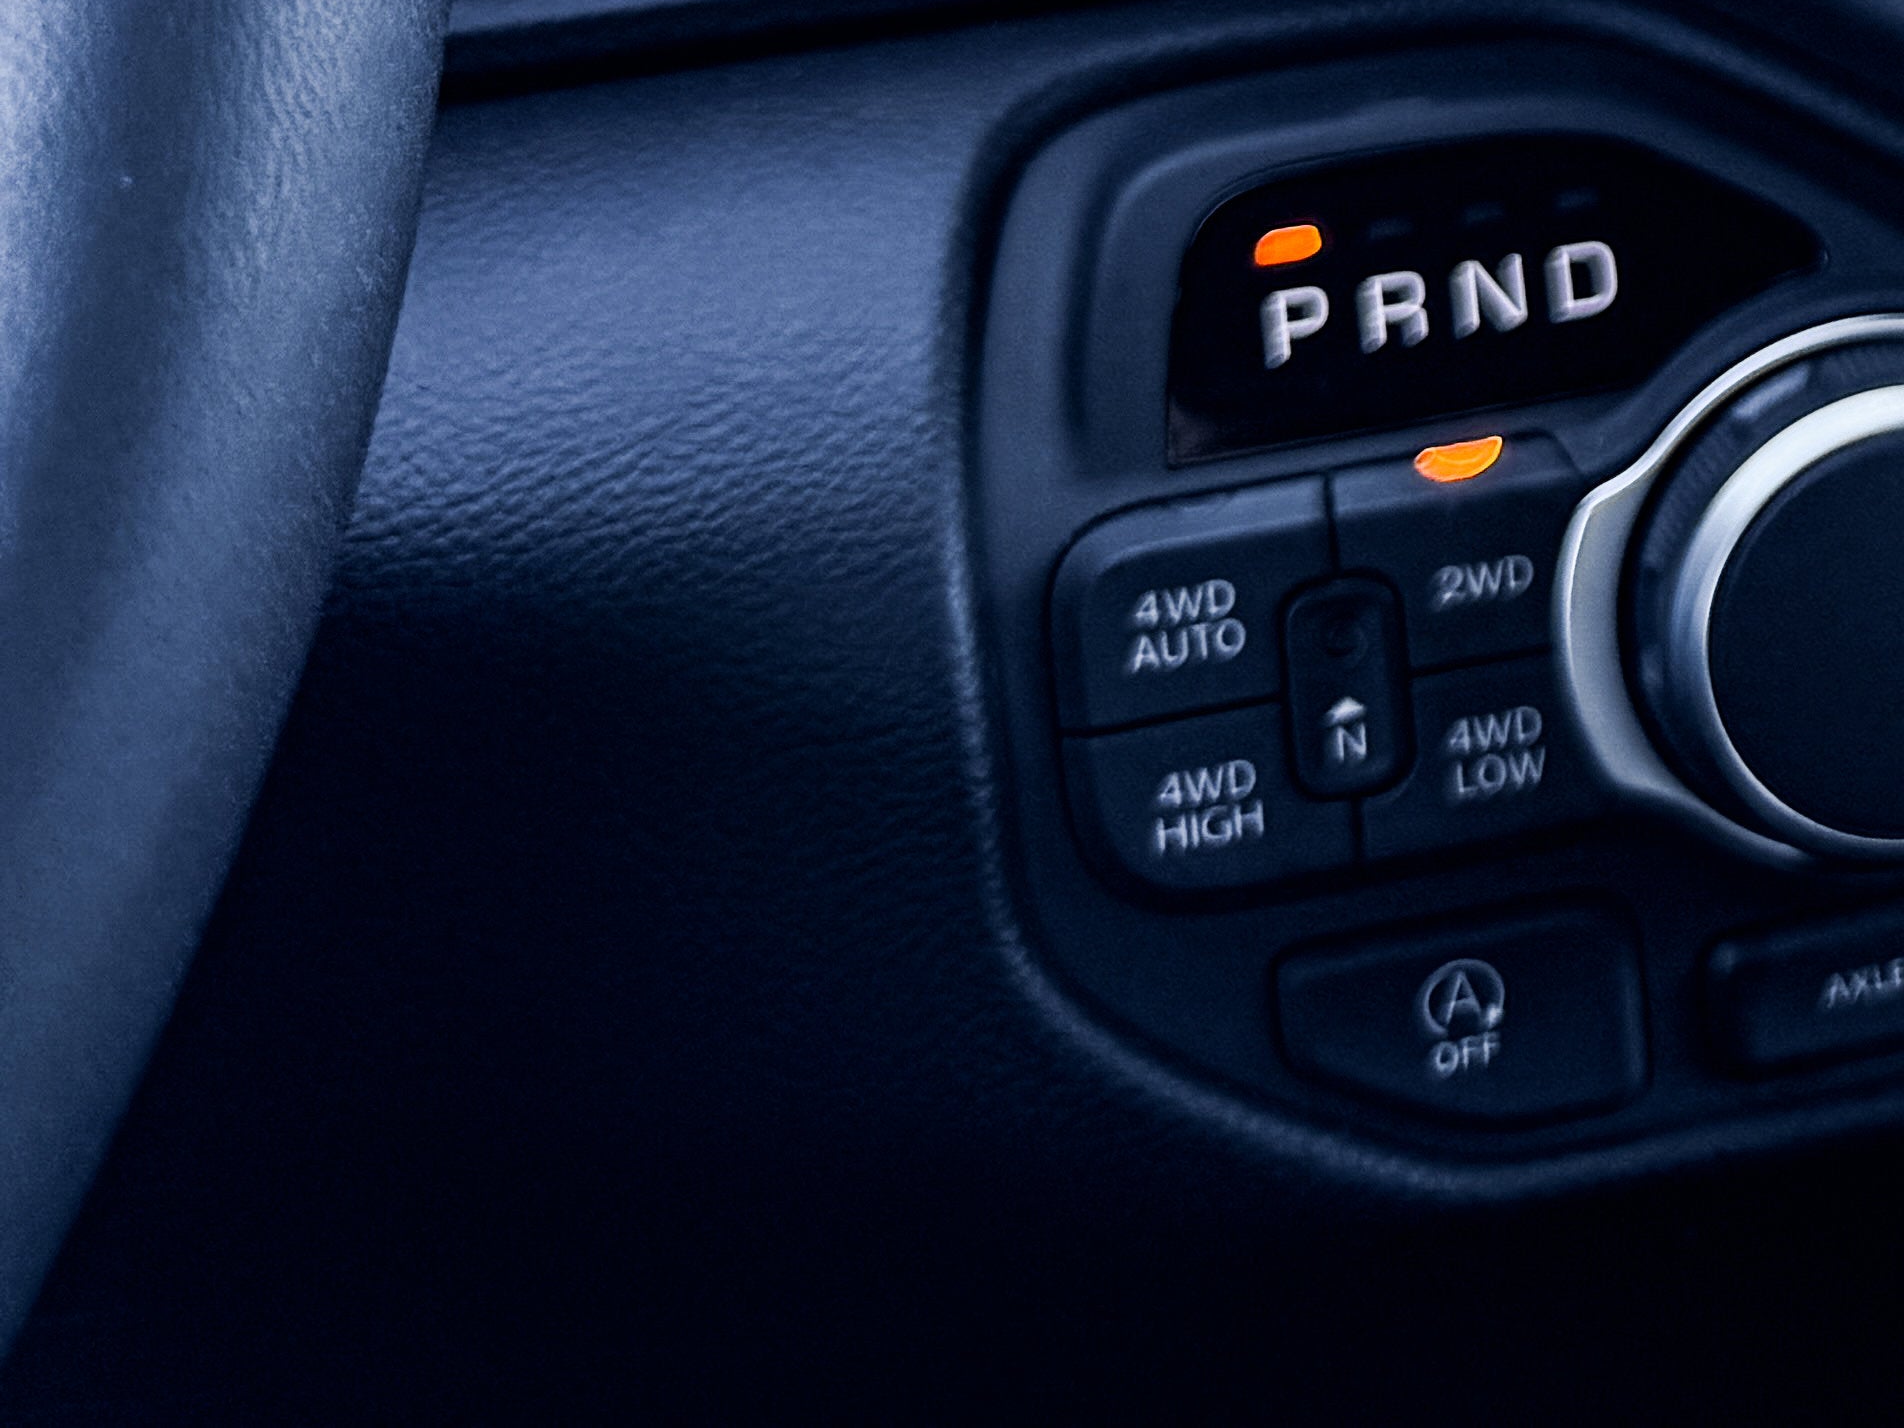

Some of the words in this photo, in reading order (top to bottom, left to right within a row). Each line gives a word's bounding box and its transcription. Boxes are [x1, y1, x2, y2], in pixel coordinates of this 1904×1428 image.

[1129, 579, 1237, 629] 4WD
[1432, 554, 1535, 611] 2WD
[1129, 617, 1247, 674] AUTO
[1442, 705, 1543, 754] 4WD
[1156, 759, 1257, 808] 4WD
[1448, 746, 1547, 799] LOW
[1152, 799, 1265, 855] HIGH
[1428, 1030, 1501, 1079] OFF
